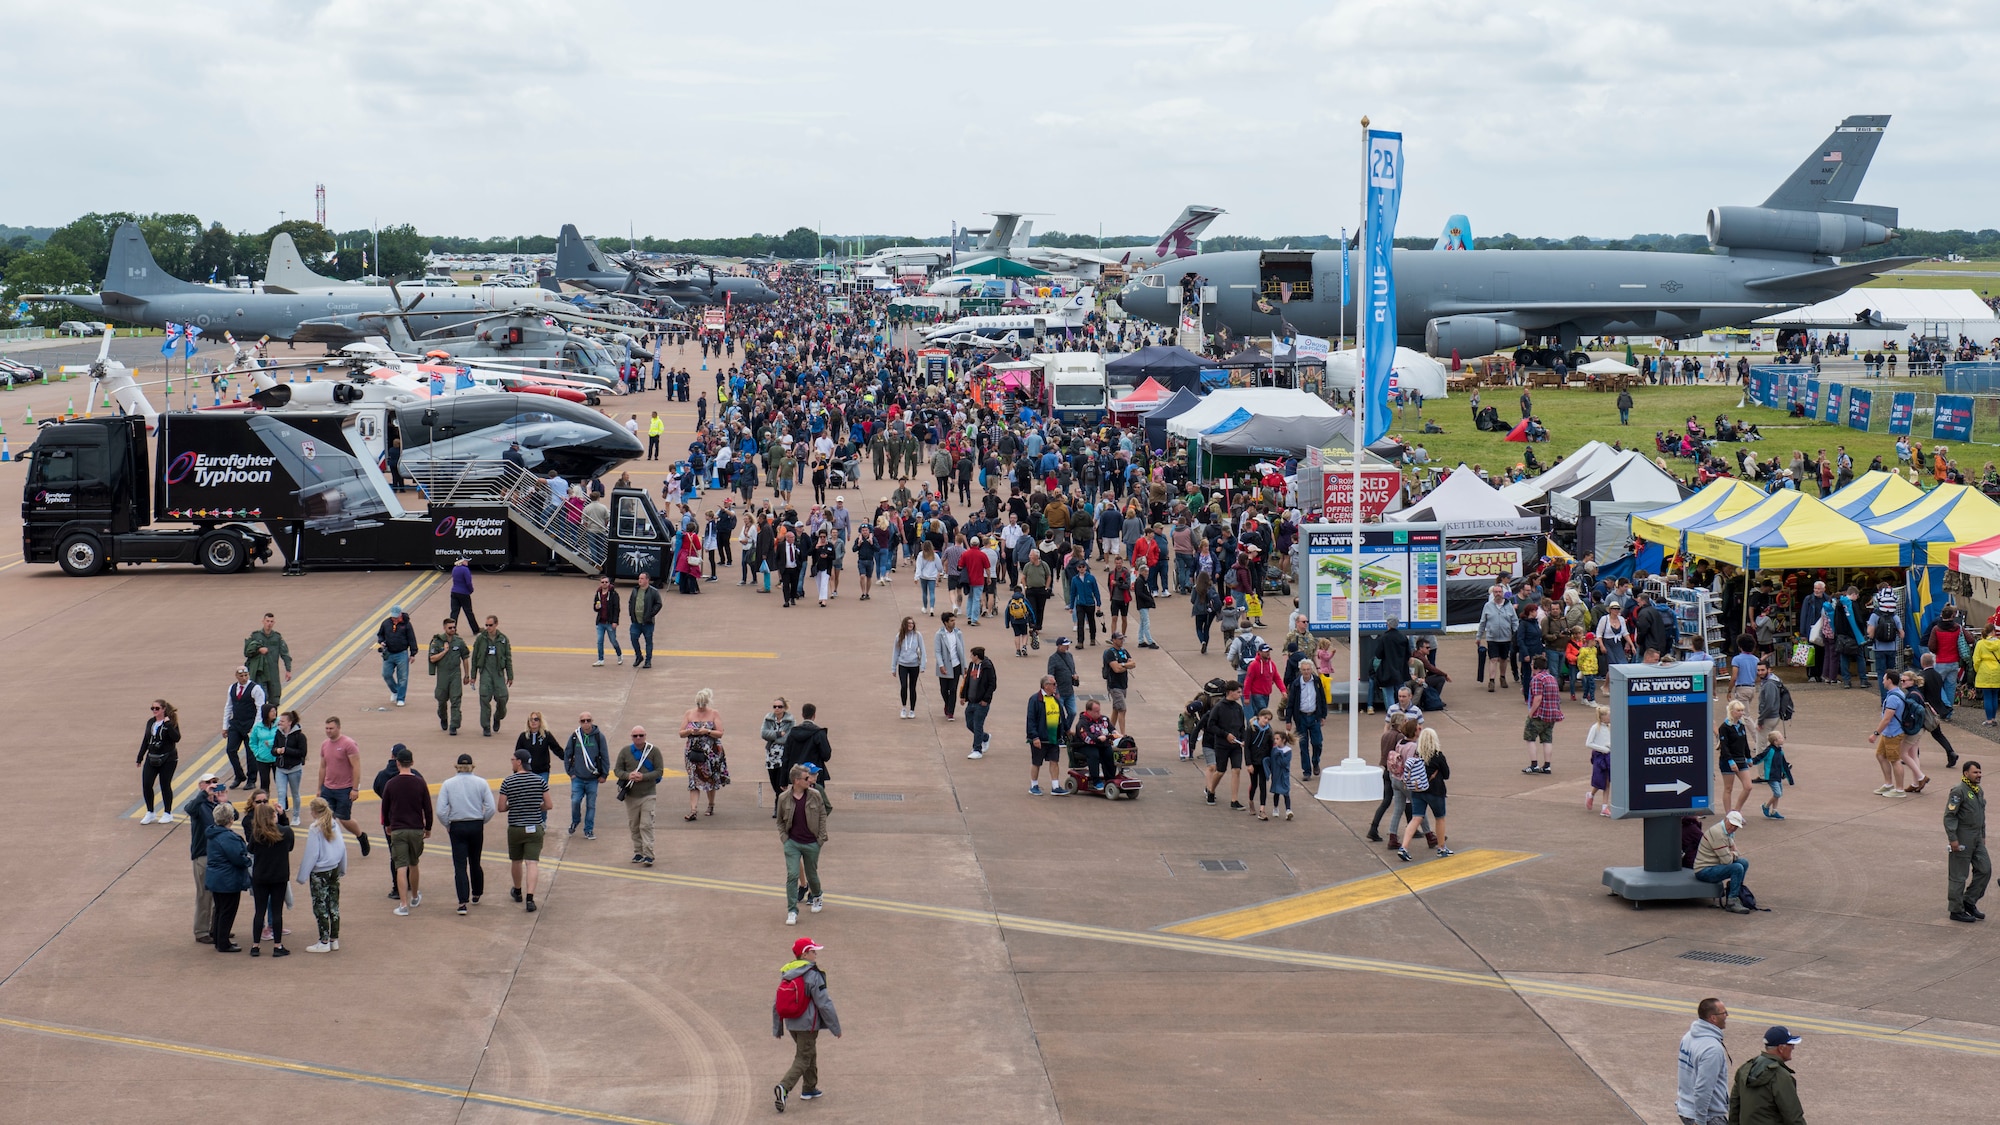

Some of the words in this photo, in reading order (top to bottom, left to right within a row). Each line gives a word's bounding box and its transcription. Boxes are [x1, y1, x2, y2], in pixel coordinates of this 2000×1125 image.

[1373, 149, 1393, 179] 2B
[1374, 266, 1388, 322] BLUE
[326, 302, 359, 310] Canada
[195, 454, 276, 469] Eurofighter
[194, 467, 271, 487] Typhoon
[456, 518, 505, 527] Eurofighter
[1446, 520, 1486, 530] KETTLE
[1487, 519, 1515, 528] CORN
[455, 526, 502, 538] Typhoon
[1311, 537, 1330, 545] AIR
[1330, 536, 1366, 545] TATTO
[1459, 552, 1517, 566] KETTLE
[1465, 563, 1513, 576] CORN
[1631, 682, 1651, 692] AIR
[1652, 681, 1691, 690] TATTOO
[1649, 696, 1667, 704] BLUE
[1656, 720, 1681, 729] FRIAT
[1644, 730, 1694, 739] ENCLOSURE
[1648, 746, 1690, 755] DISABLED
[1644, 755, 1694, 765] ENCLOSURE
